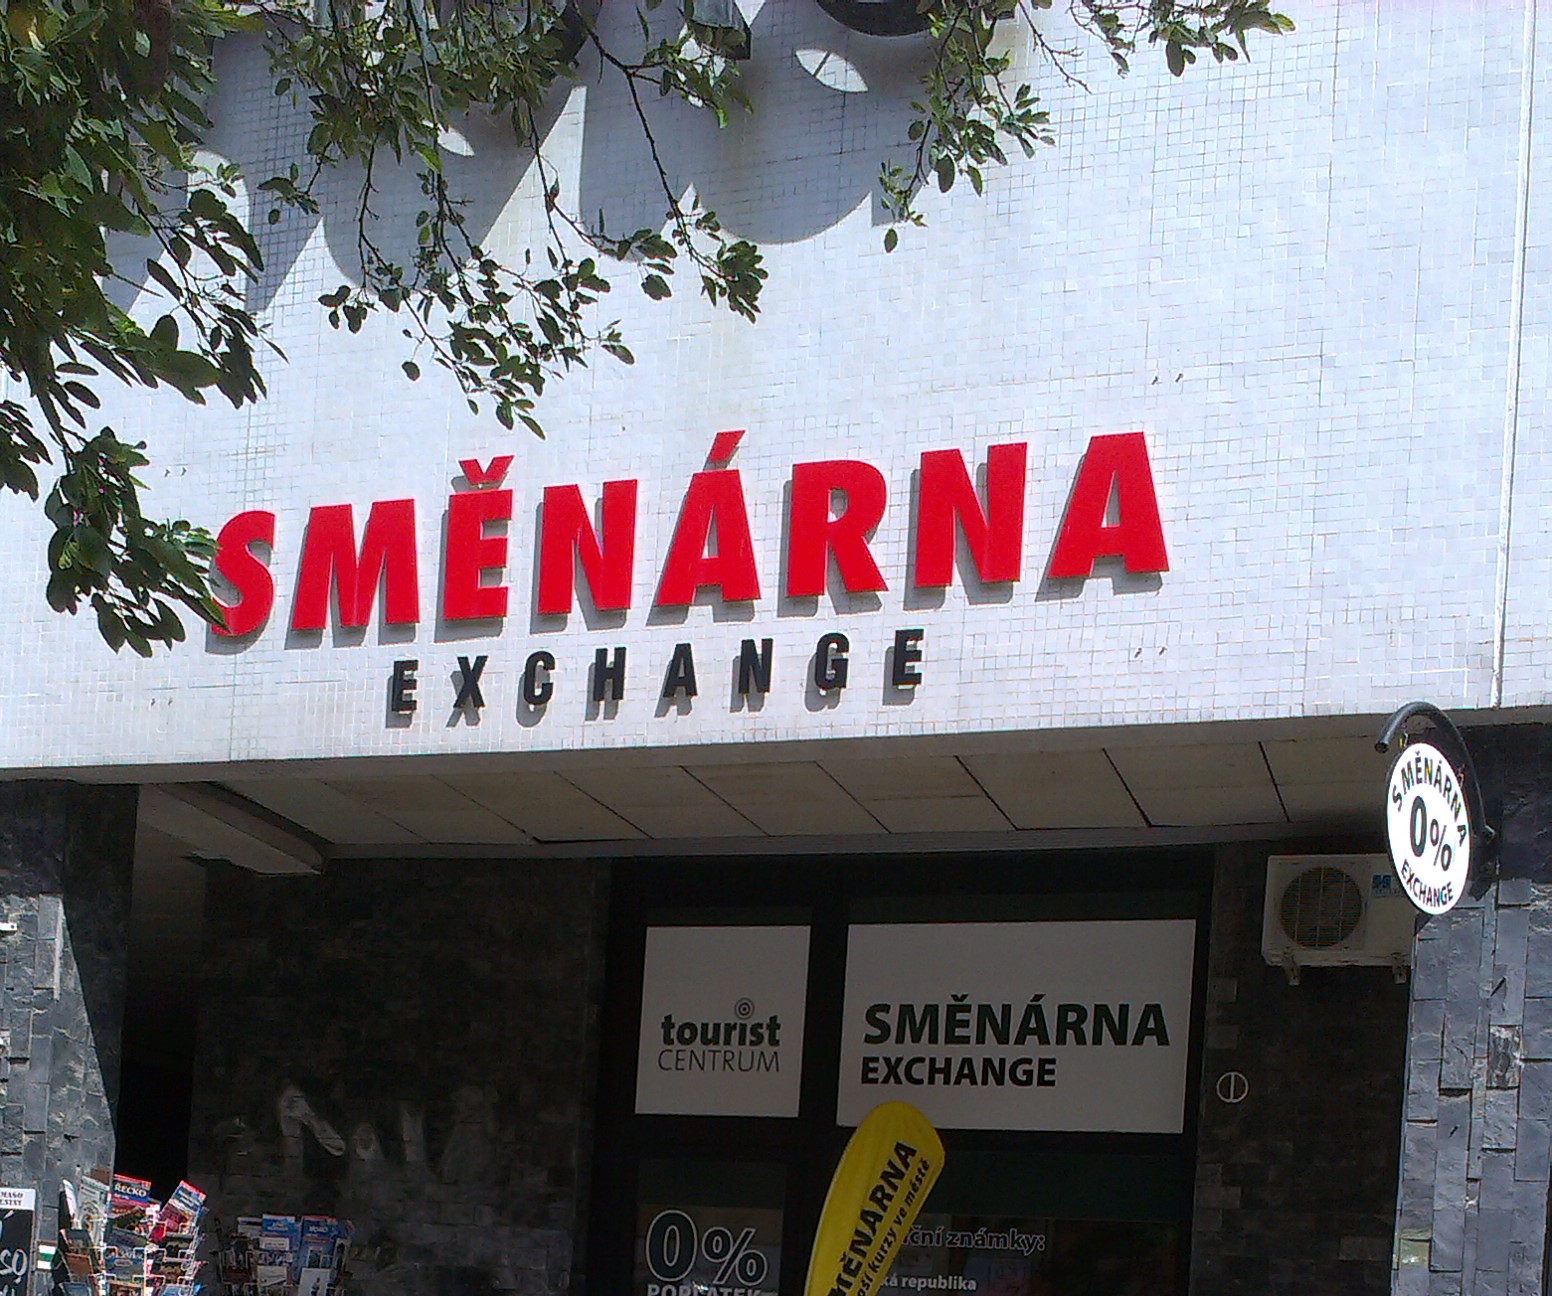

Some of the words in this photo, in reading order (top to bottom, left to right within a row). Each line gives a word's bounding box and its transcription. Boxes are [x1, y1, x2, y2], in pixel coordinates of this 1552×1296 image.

[209, 429, 1170, 637] SMĚNÁRNA
[390, 627, 926, 712] EXCHANGE
[1392, 750, 1468, 847] SMĚNÁRNA
[1409, 795, 1453, 872] 0%
[1400, 858, 1454, 908] EXCHANGE
[661, 1010, 781, 1047] tourist
[863, 994, 1170, 1047] SMĚNÁRNA
[658, 1049, 780, 1073] CENTRUM
[860, 1057, 1057, 1087] EXCHANGE
[646, 1209, 769, 1287] 0%
[868, 1228, 898, 1277] kurzy
[893, 1207, 908, 1227] ve
[946, 1225, 1046, 1257] známky:
[902, 1275, 977, 1292] republika
